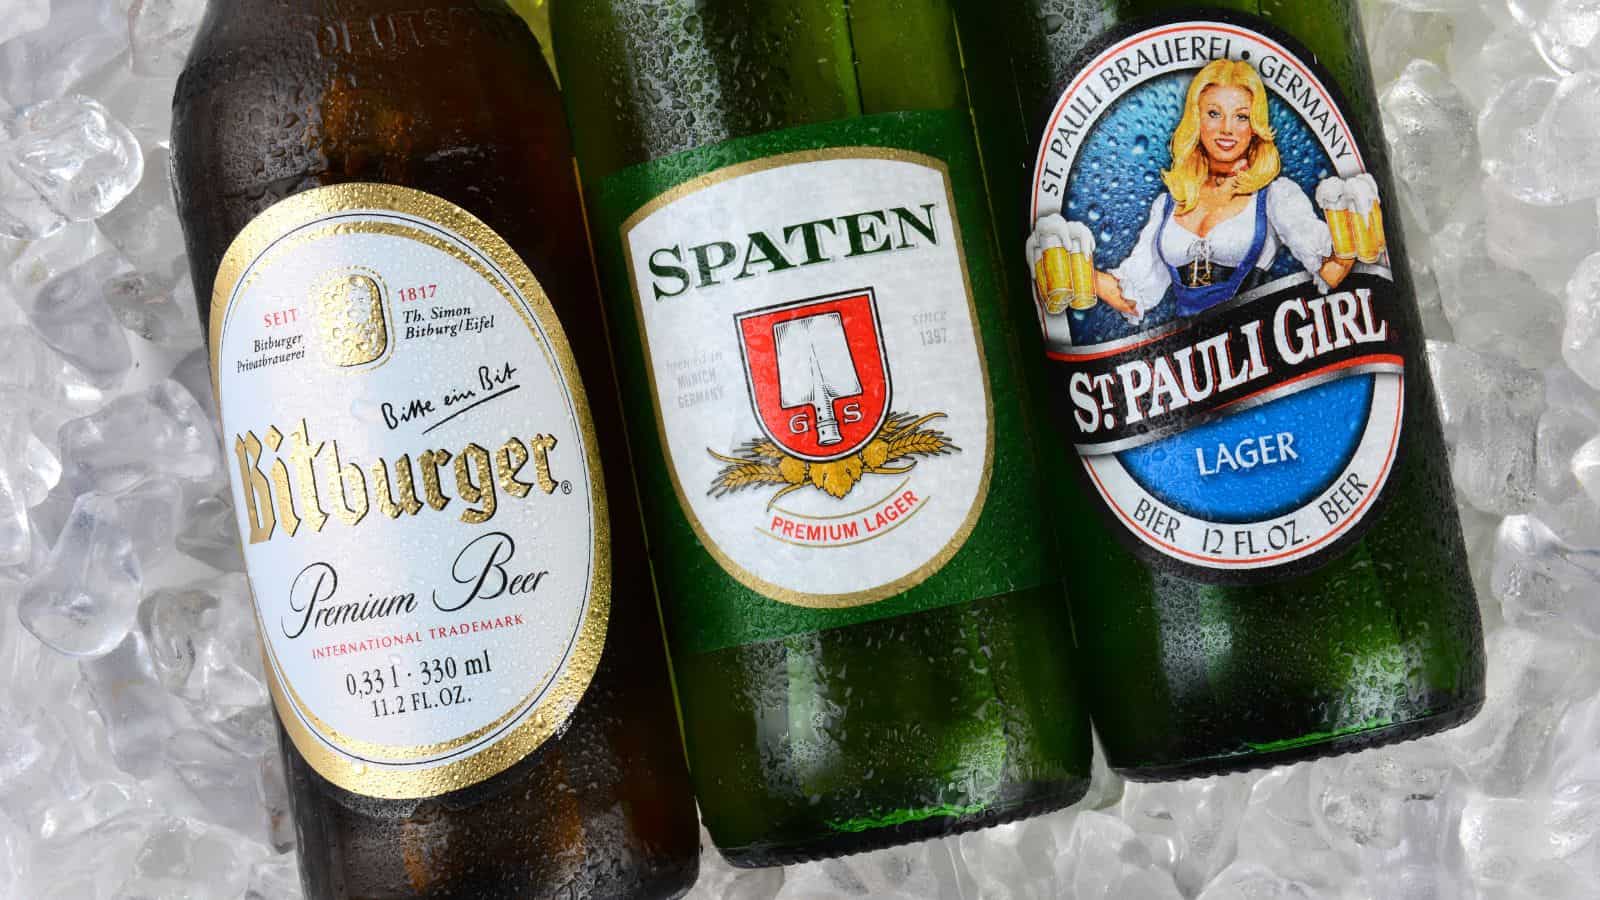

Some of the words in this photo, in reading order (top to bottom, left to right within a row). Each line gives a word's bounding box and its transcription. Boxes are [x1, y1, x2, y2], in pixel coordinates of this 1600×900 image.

[1099, 36, 1231, 92] BRAUEREI
[1051, 84, 1103, 160] PAULI
[1258, 55, 1353, 160] GERMANY
[1042, 162, 1063, 197] ST.
[647, 204, 938, 301] SPATEN
[398, 284, 437, 302] 1817
[263, 308, 297, 328] SEIT
[403, 309, 425, 324] Th.
[431, 306, 472, 319] Simon
[405, 315, 495, 339] Bitburg/Eifel
[254, 334, 303, 352] Bitburger
[920, 328, 947, 346] 1397
[1116, 320, 1272, 425] PAULI
[1273, 288, 1389, 365] GIRL
[237, 346, 305, 373] Privatbrauerei
[381, 400, 435, 430] Bitte
[444, 389, 476, 405] ein
[478, 361, 517, 391] Bit
[677, 385, 725, 408] GERMANY
[843, 403, 862, 424] S
[788, 413, 810, 434] G
[1195, 431, 1299, 476] LAGER
[770, 515, 859, 541] PREMIUM
[863, 489, 919, 532] LAGER
[1133, 497, 1181, 543] BIER
[1202, 527, 1224, 554] 12
[1318, 471, 1369, 524] BEER
[281, 562, 417, 639] Premium
[432, 531, 549, 613] Beer
[311, 631, 423, 660] INTERNATIONAL
[428, 614, 525, 640] TRADEMARK
[345, 668, 384, 699] 0,33
[419, 656, 457, 686] 330
[464, 649, 492, 676] ml
[372, 695, 406, 719] 11.2
